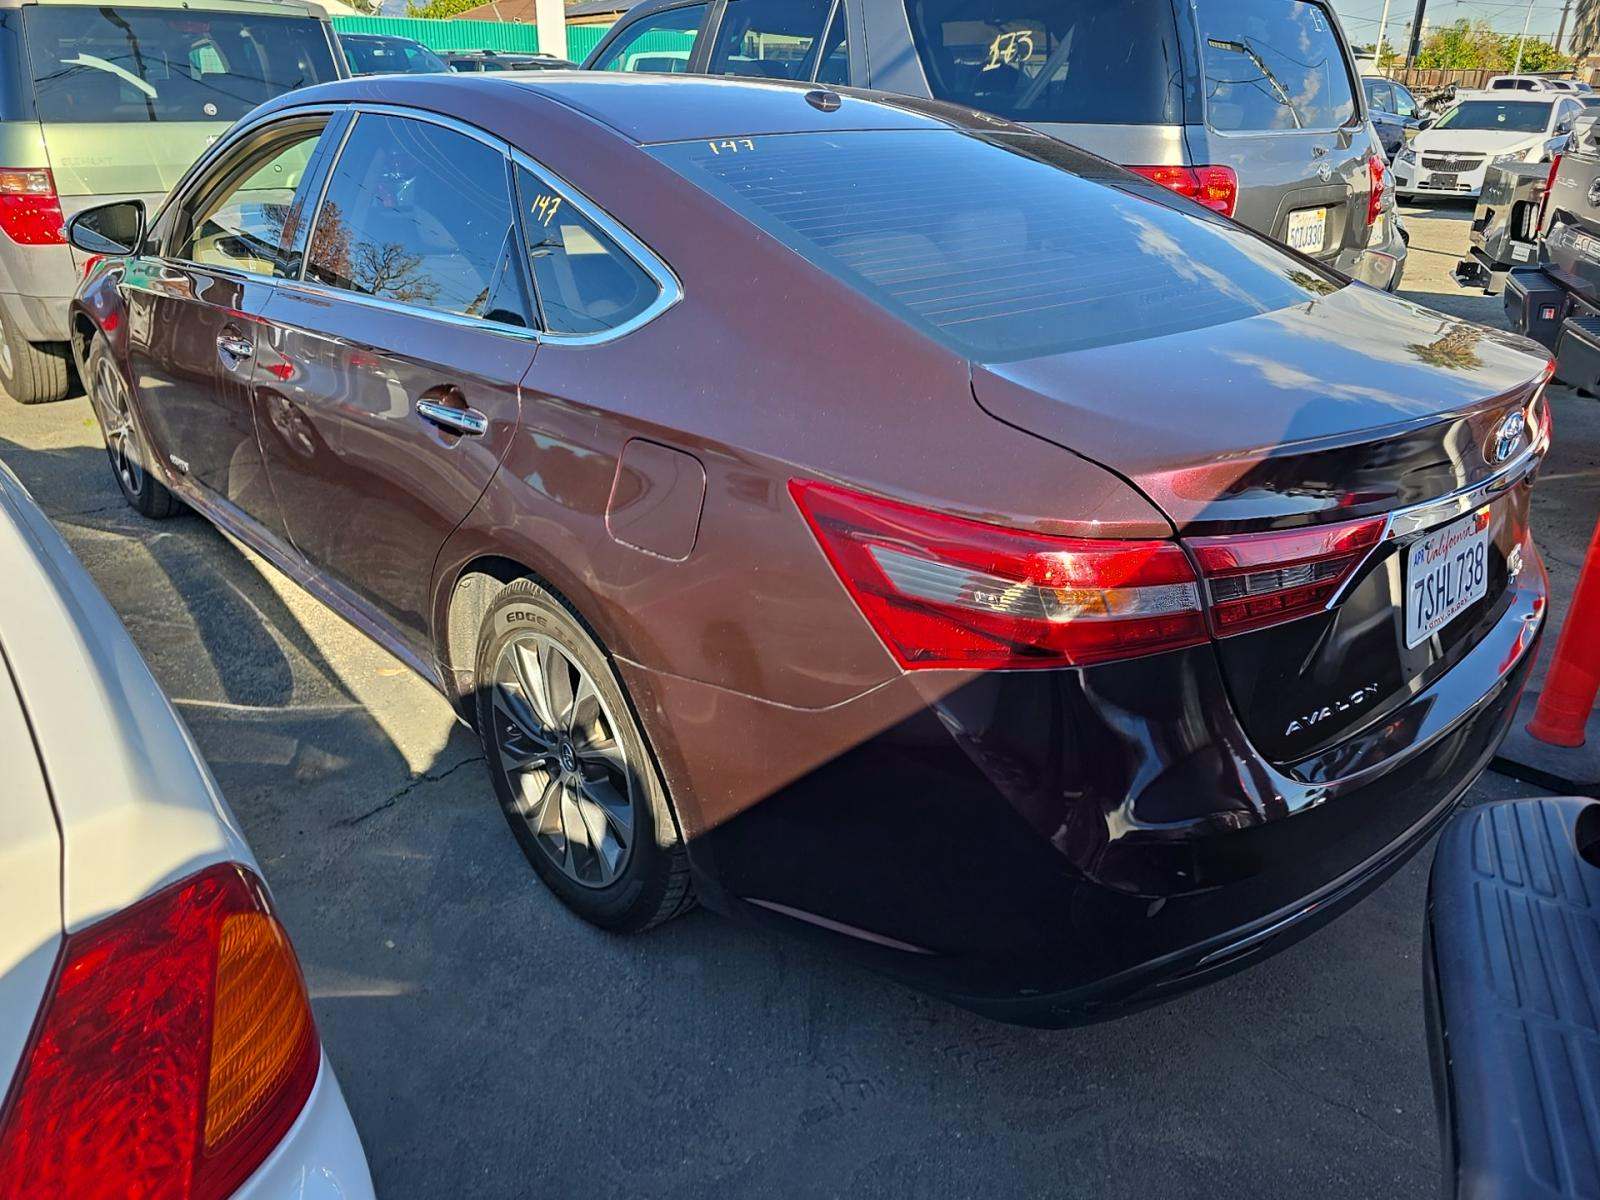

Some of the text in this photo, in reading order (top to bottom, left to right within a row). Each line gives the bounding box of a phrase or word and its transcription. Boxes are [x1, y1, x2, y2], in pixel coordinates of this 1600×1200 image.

[983, 31, 1033, 71] 173
[709, 140, 754, 155] 147
[531, 194, 561, 227] 147
[1414, 549, 1425, 567] APR
[1426, 525, 1477, 565] California
[506, 611, 548, 628] EDGE
[1285, 683, 1378, 736] AVALON
